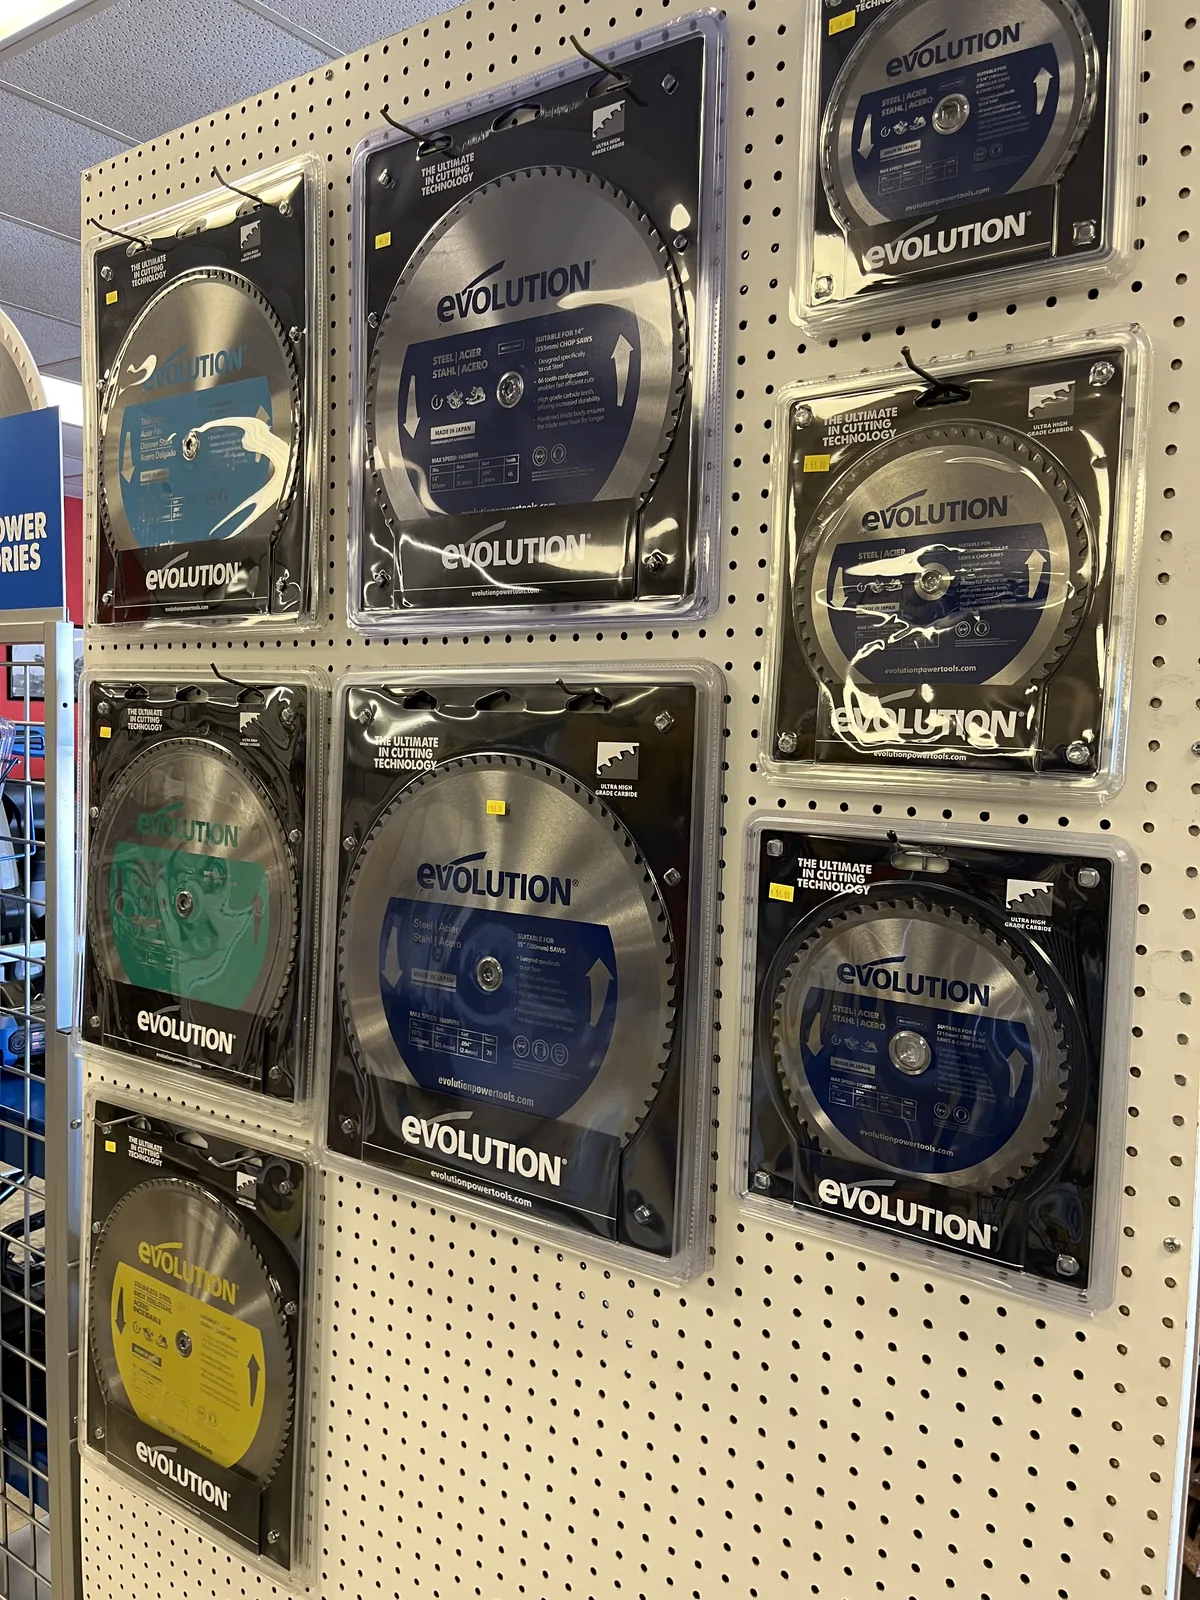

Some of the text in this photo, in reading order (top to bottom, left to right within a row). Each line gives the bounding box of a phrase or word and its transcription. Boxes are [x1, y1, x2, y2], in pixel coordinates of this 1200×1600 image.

[882, 88, 927, 107] STEEL ACIER
[881, 96, 933, 117] STAHL ACERO
[421, 152, 474, 177] THE ULTIMATE
[425, 166, 470, 186] IN CUTTING
[421, 172, 473, 196] TECHNOLOGY
[905, 186, 990, 212] evolutionpowertools.com
[131, 255, 166, 271] THE ULTIMATE
[140, 264, 164, 277] CUTTING
[132, 271, 166, 287] TECHNOLOGY
[535, 331, 561, 343] SUITABLE
[560, 339, 576, 348] CHOP
[577, 336, 593, 344] SAWS
[433, 348, 481, 365] STEEL ACIER
[539, 351, 586, 364] Designed specifically
[433, 360, 488, 379] STAHL ACERO
[553, 362, 564, 370] Steel
[558, 370, 589, 380] configuration
[565, 379, 583, 387] efficient
[549, 394, 562, 402] grade
[578, 396, 600, 404] durability
[823, 407, 898, 426] THE ULTIMATE
[828, 420, 892, 436] IN CUTTING
[1033, 420, 1068, 430] ULTRA HIGH
[1048, 426, 1074, 435] CARBIDE
[435, 428, 448, 436] MADE
[822, 428, 897, 446] TECHNOLOGY
[0, 543, 40, 572] RIES
[858, 548, 906, 560] STEEL ACIER
[885, 664, 976, 675] evolutionpowertools.com
[128, 708, 162, 716] THE ULTIMATE
[137, 716, 160, 724] CUTTING
[128, 723, 162, 731] TECHNOLOGY
[374, 736, 439, 748] THE ULTIMATE
[378, 747, 433, 759] IN CUTTING
[374, 758, 437, 771] TECHNOLOGY
[614, 790, 638, 798] CARBIDE
[797, 858, 872, 875] THE ULTIMATE
[802, 868, 866, 884] IN CUTTING
[797, 878, 870, 895] TECHNOLOGY
[414, 919, 459, 934] Steel Acier
[1004, 921, 1052, 932] GRADE CARBIDE
[1010, 916, 1046, 926] ULTRA HIGH
[413, 933, 461, 948] Stahl Acero
[517, 933, 542, 942] SUITABLE
[550, 946, 566, 954] SAWS
[430, 972, 436, 980] IN
[437, 973, 454, 984] JAPAN
[410, 1011, 421, 1019] MAX
[833, 1005, 880, 1019] STEEL ACIER
[832, 1014, 886, 1030] STAHL ACERO
[438, 1076, 534, 1107] evolutionpowertools.com
[128, 1136, 163, 1153] THE ULTIMATE
[860, 1128, 954, 1157] evolutionpowertools.com
[128, 1150, 162, 1166] TECHNOLOGY
[137, 1146, 160, 1159] CUTTING
[431, 1169, 532, 1208] evolutionpowertools.com
